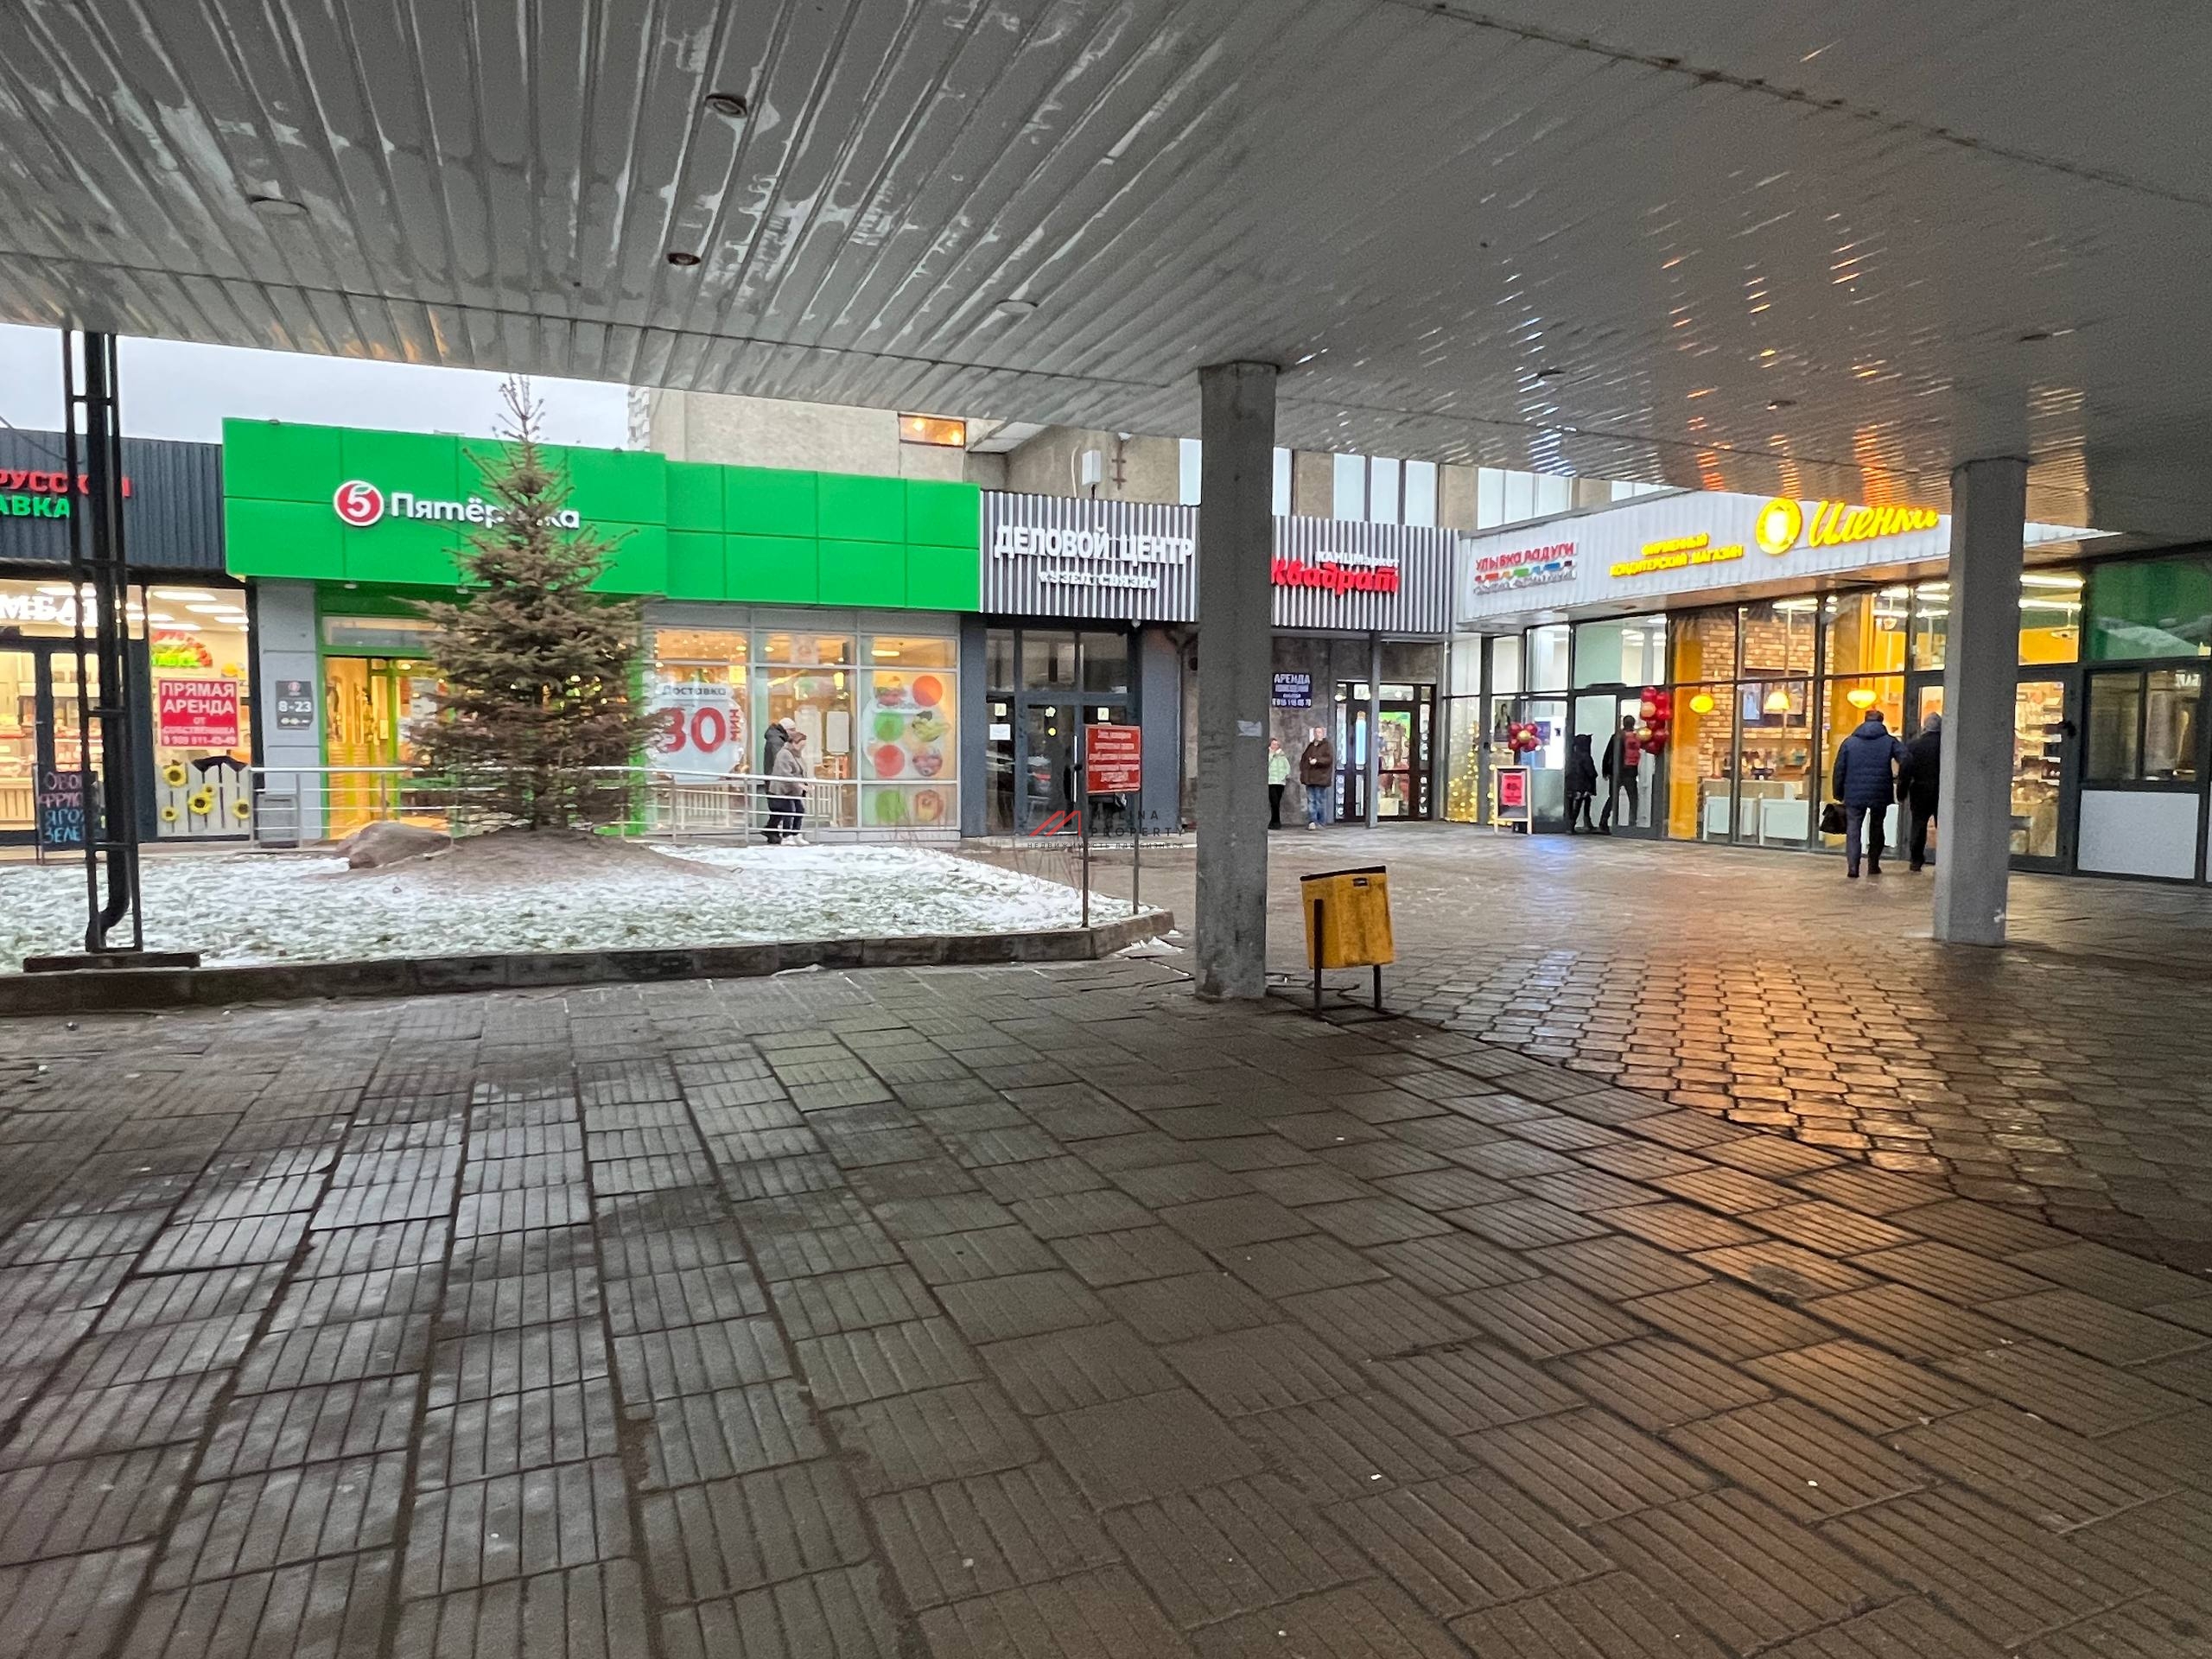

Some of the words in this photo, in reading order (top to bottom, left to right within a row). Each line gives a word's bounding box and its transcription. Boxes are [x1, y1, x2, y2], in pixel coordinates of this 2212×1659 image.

[995, 524, 1109, 559] ДЕЛОВОЙ
[1120, 534, 1195, 567] ЦЕНТР
[1274, 673, 1311, 684] АРЕНДА
[161, 682, 235, 697] ПРЯМАЯ
[162, 698, 235, 716] АРЕНДА
